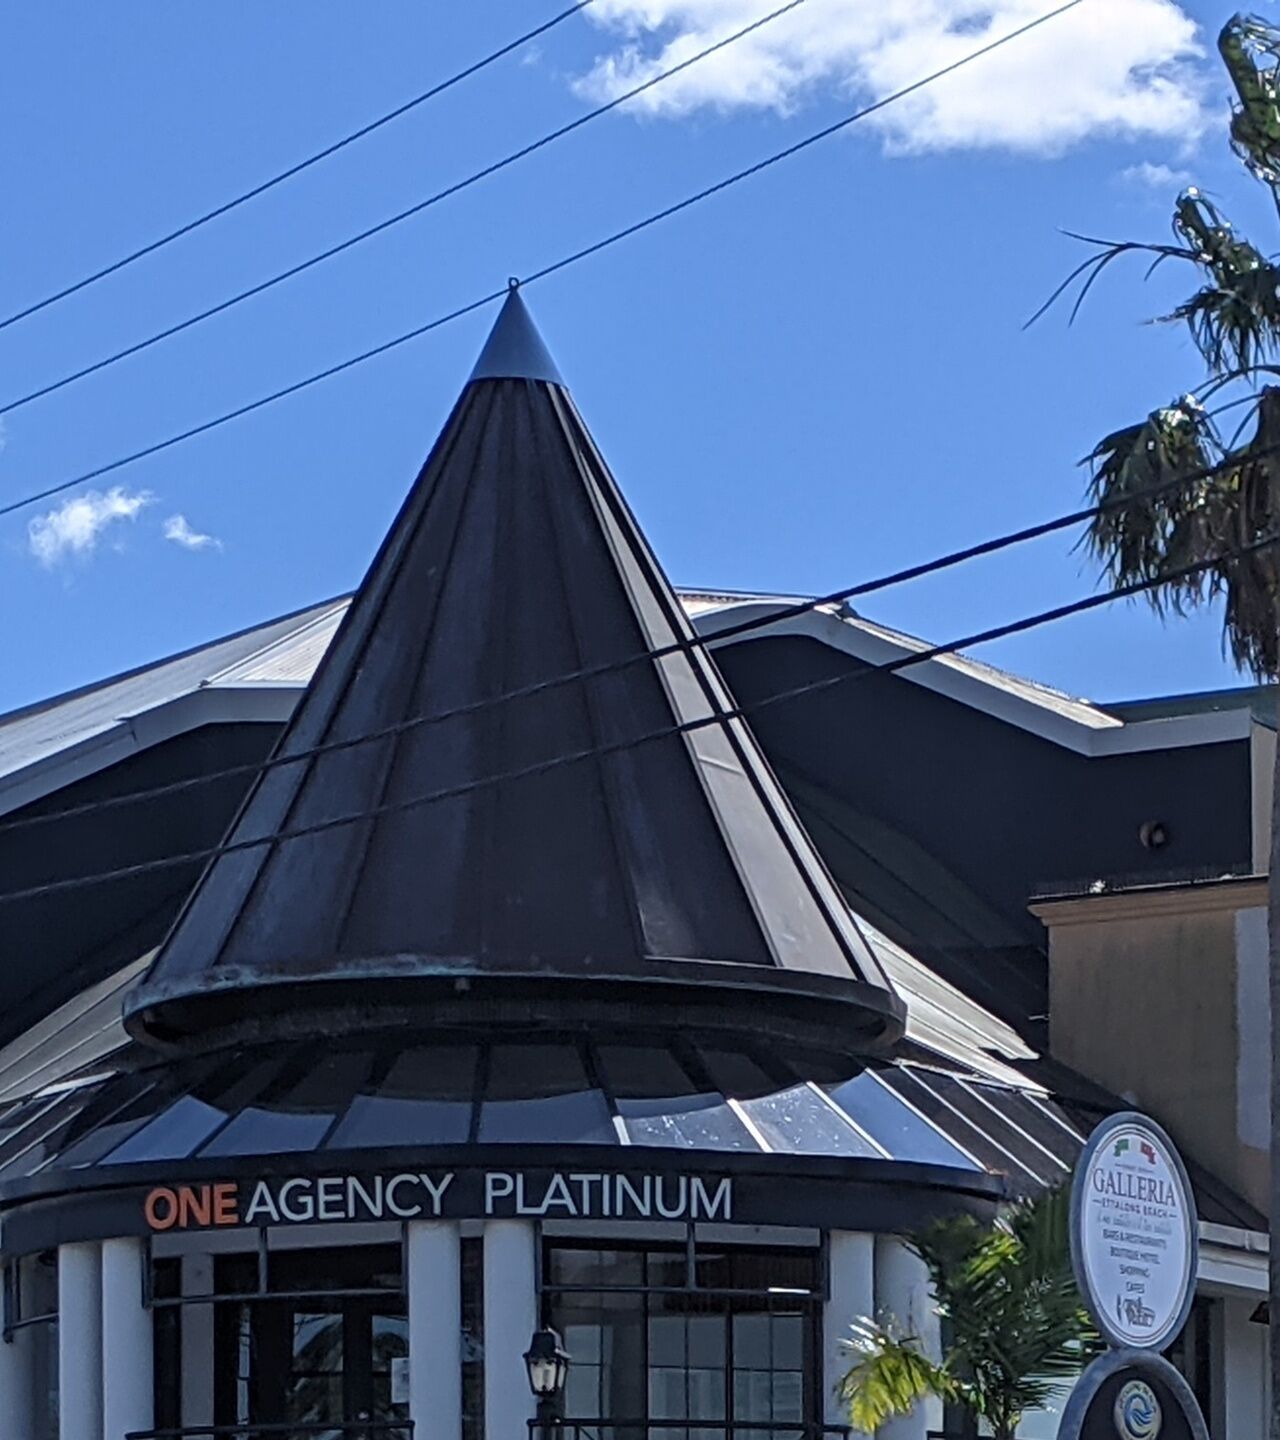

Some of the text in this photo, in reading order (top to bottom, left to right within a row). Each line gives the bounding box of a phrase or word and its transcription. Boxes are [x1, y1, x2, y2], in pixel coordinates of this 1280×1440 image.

[144, 1173, 732, 1230] ONE AGENCY PLATINUM
[1092, 1167, 1176, 1207] GALLERIA
